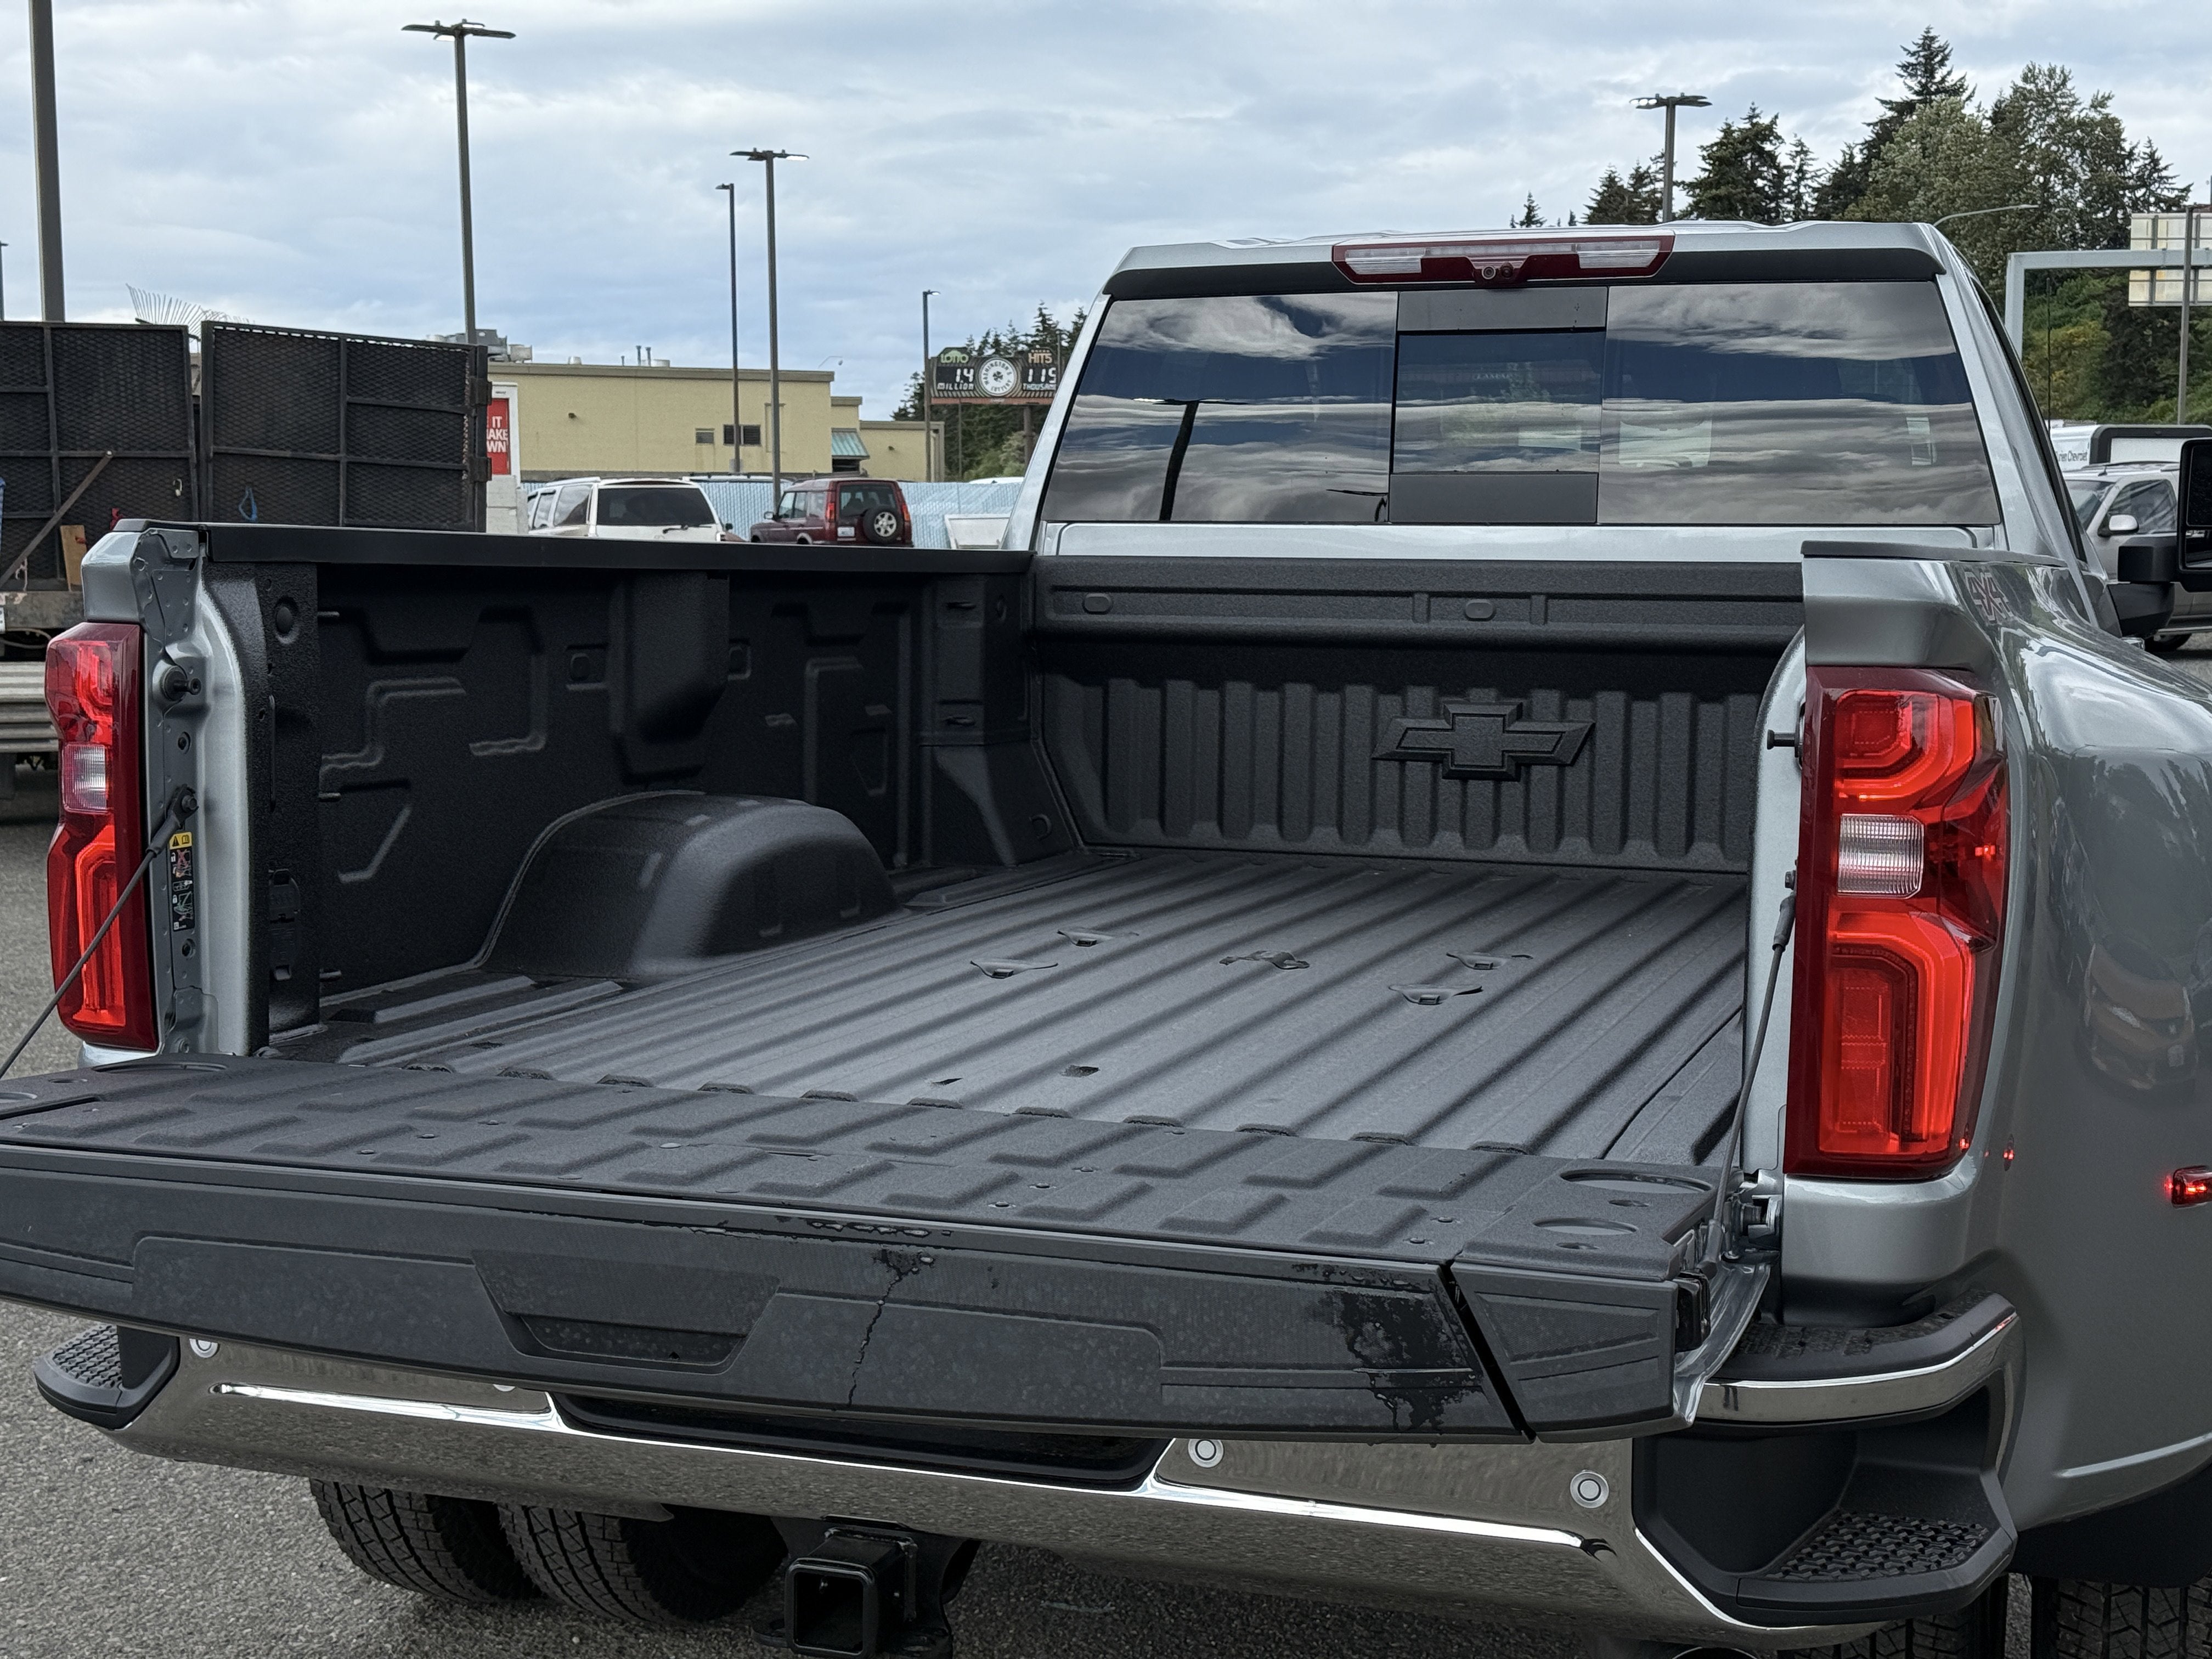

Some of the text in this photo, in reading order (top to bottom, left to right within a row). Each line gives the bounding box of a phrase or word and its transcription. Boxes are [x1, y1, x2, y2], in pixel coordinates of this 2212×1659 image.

[956, 368, 974, 383] 1.4
[492, 416, 503, 428] IT
[487, 428, 508, 441] AKE
[487, 441, 506, 453] WN
